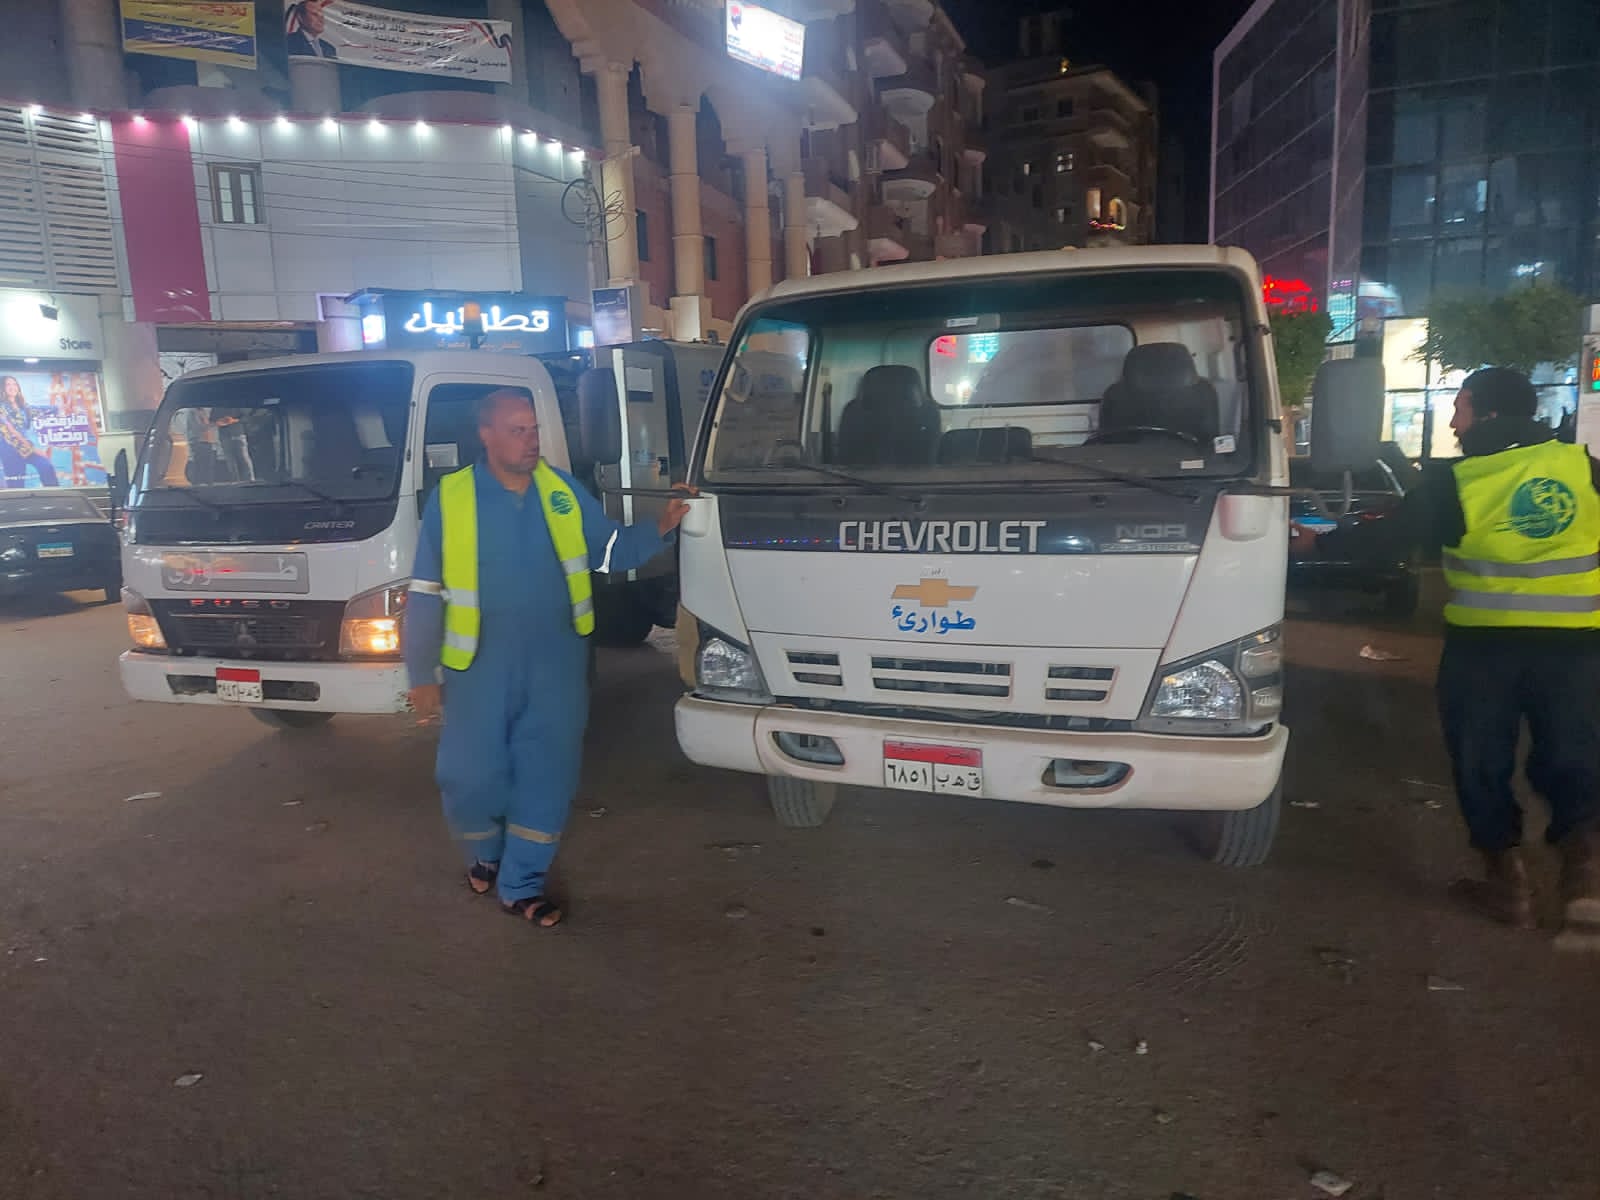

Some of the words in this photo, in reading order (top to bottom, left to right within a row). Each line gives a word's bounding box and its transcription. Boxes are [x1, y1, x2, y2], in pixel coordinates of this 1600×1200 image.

[59, 338, 93, 350] Store
[38, 427, 88, 446] رمضان
[304, 520, 355, 530] CANTER
[838, 520, 1047, 553] CHEVROLET
[887, 763, 929, 786] ٦٨٥١
